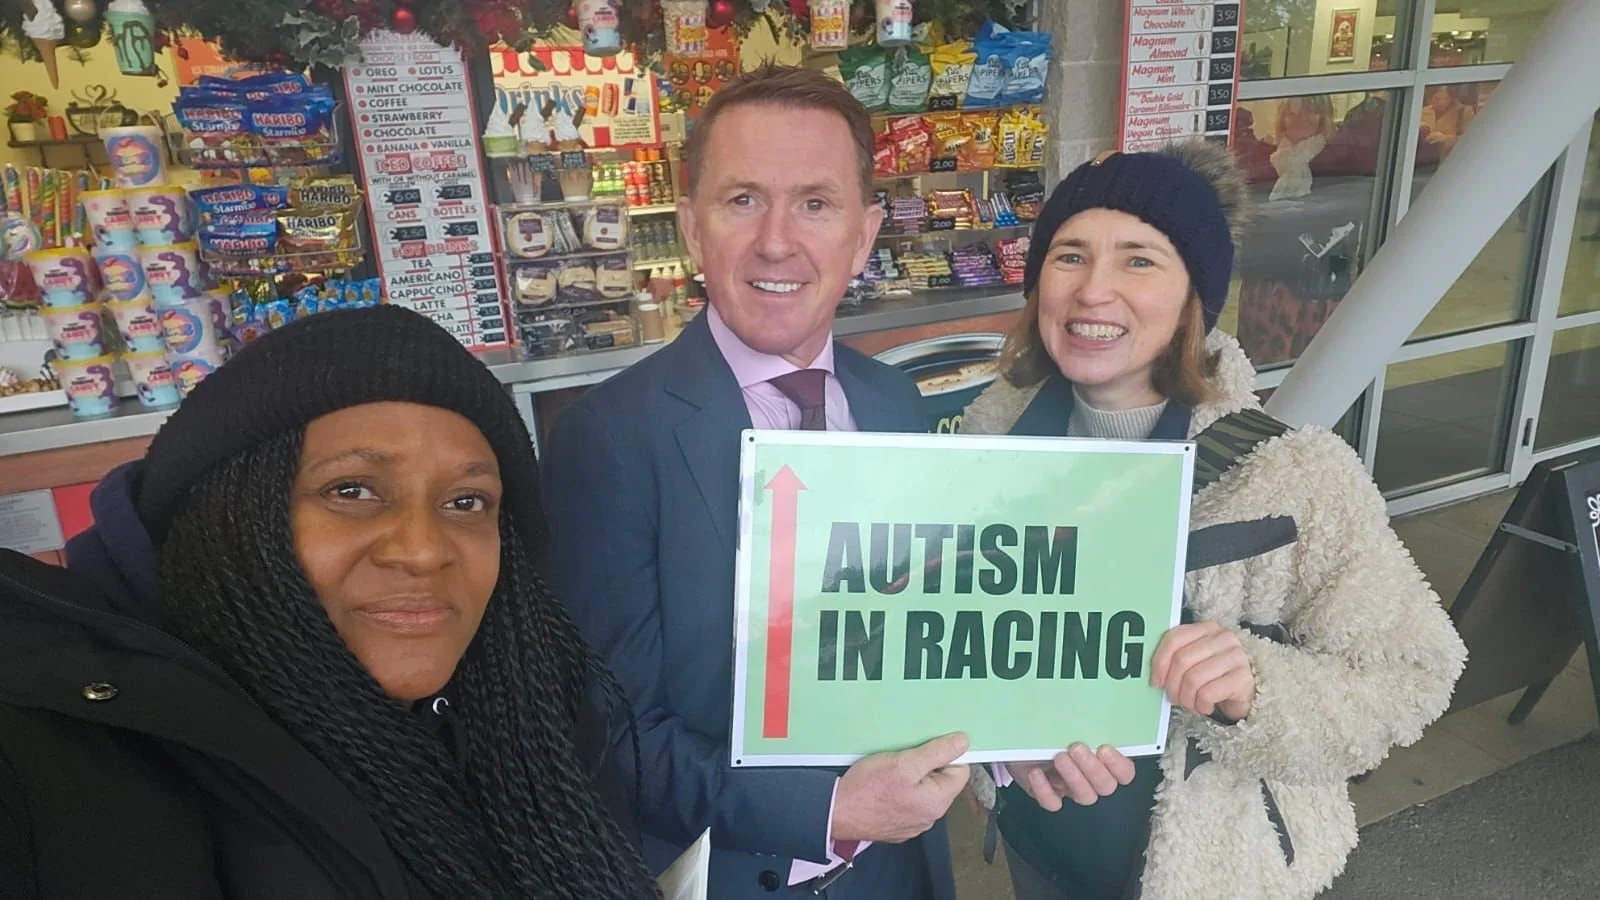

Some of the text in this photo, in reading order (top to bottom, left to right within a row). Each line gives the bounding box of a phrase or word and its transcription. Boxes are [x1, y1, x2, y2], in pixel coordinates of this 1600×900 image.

[1134, 7, 1169, 18] Magnum
[1133, 37, 1176, 48] Magnum
[1150, 48, 1188, 58] Almond
[366, 66, 454, 77] OREO LOTUS
[1132, 66, 1174, 76] Magnum
[850, 76, 882, 88] PIPERS
[1156, 74, 1176, 83] Mint
[367, 82, 462, 94] MINT CHOCOLATE
[1166, 92, 1184, 101] Gold
[368, 98, 408, 108] COFFEE
[254, 113, 305, 126] HARIBO
[372, 112, 443, 123] STRAWBERRY
[1128, 117, 1170, 128] Magnum
[262, 126, 307, 137] Starmix
[374, 126, 436, 138] CHOCOLATE
[376, 139, 472, 152] BANANA VANILLA
[376, 154, 468, 173] ICED COFFEE
[301, 191, 351, 205] HARIBO
[212, 202, 256, 214] Starmix
[388, 205, 477, 220] CANS BOTTLES
[287, 216, 336, 229] HARIBO
[392, 240, 479, 258] HOT DRINKS
[411, 259, 432, 268] TEA
[391, 270, 461, 286] AMERICANO
[390, 284, 464, 299] CAPPUCCINO
[414, 300, 446, 310] LATTE
[821, 522, 1078, 595] AUTISM
[818, 610, 1145, 680] IN RACING
